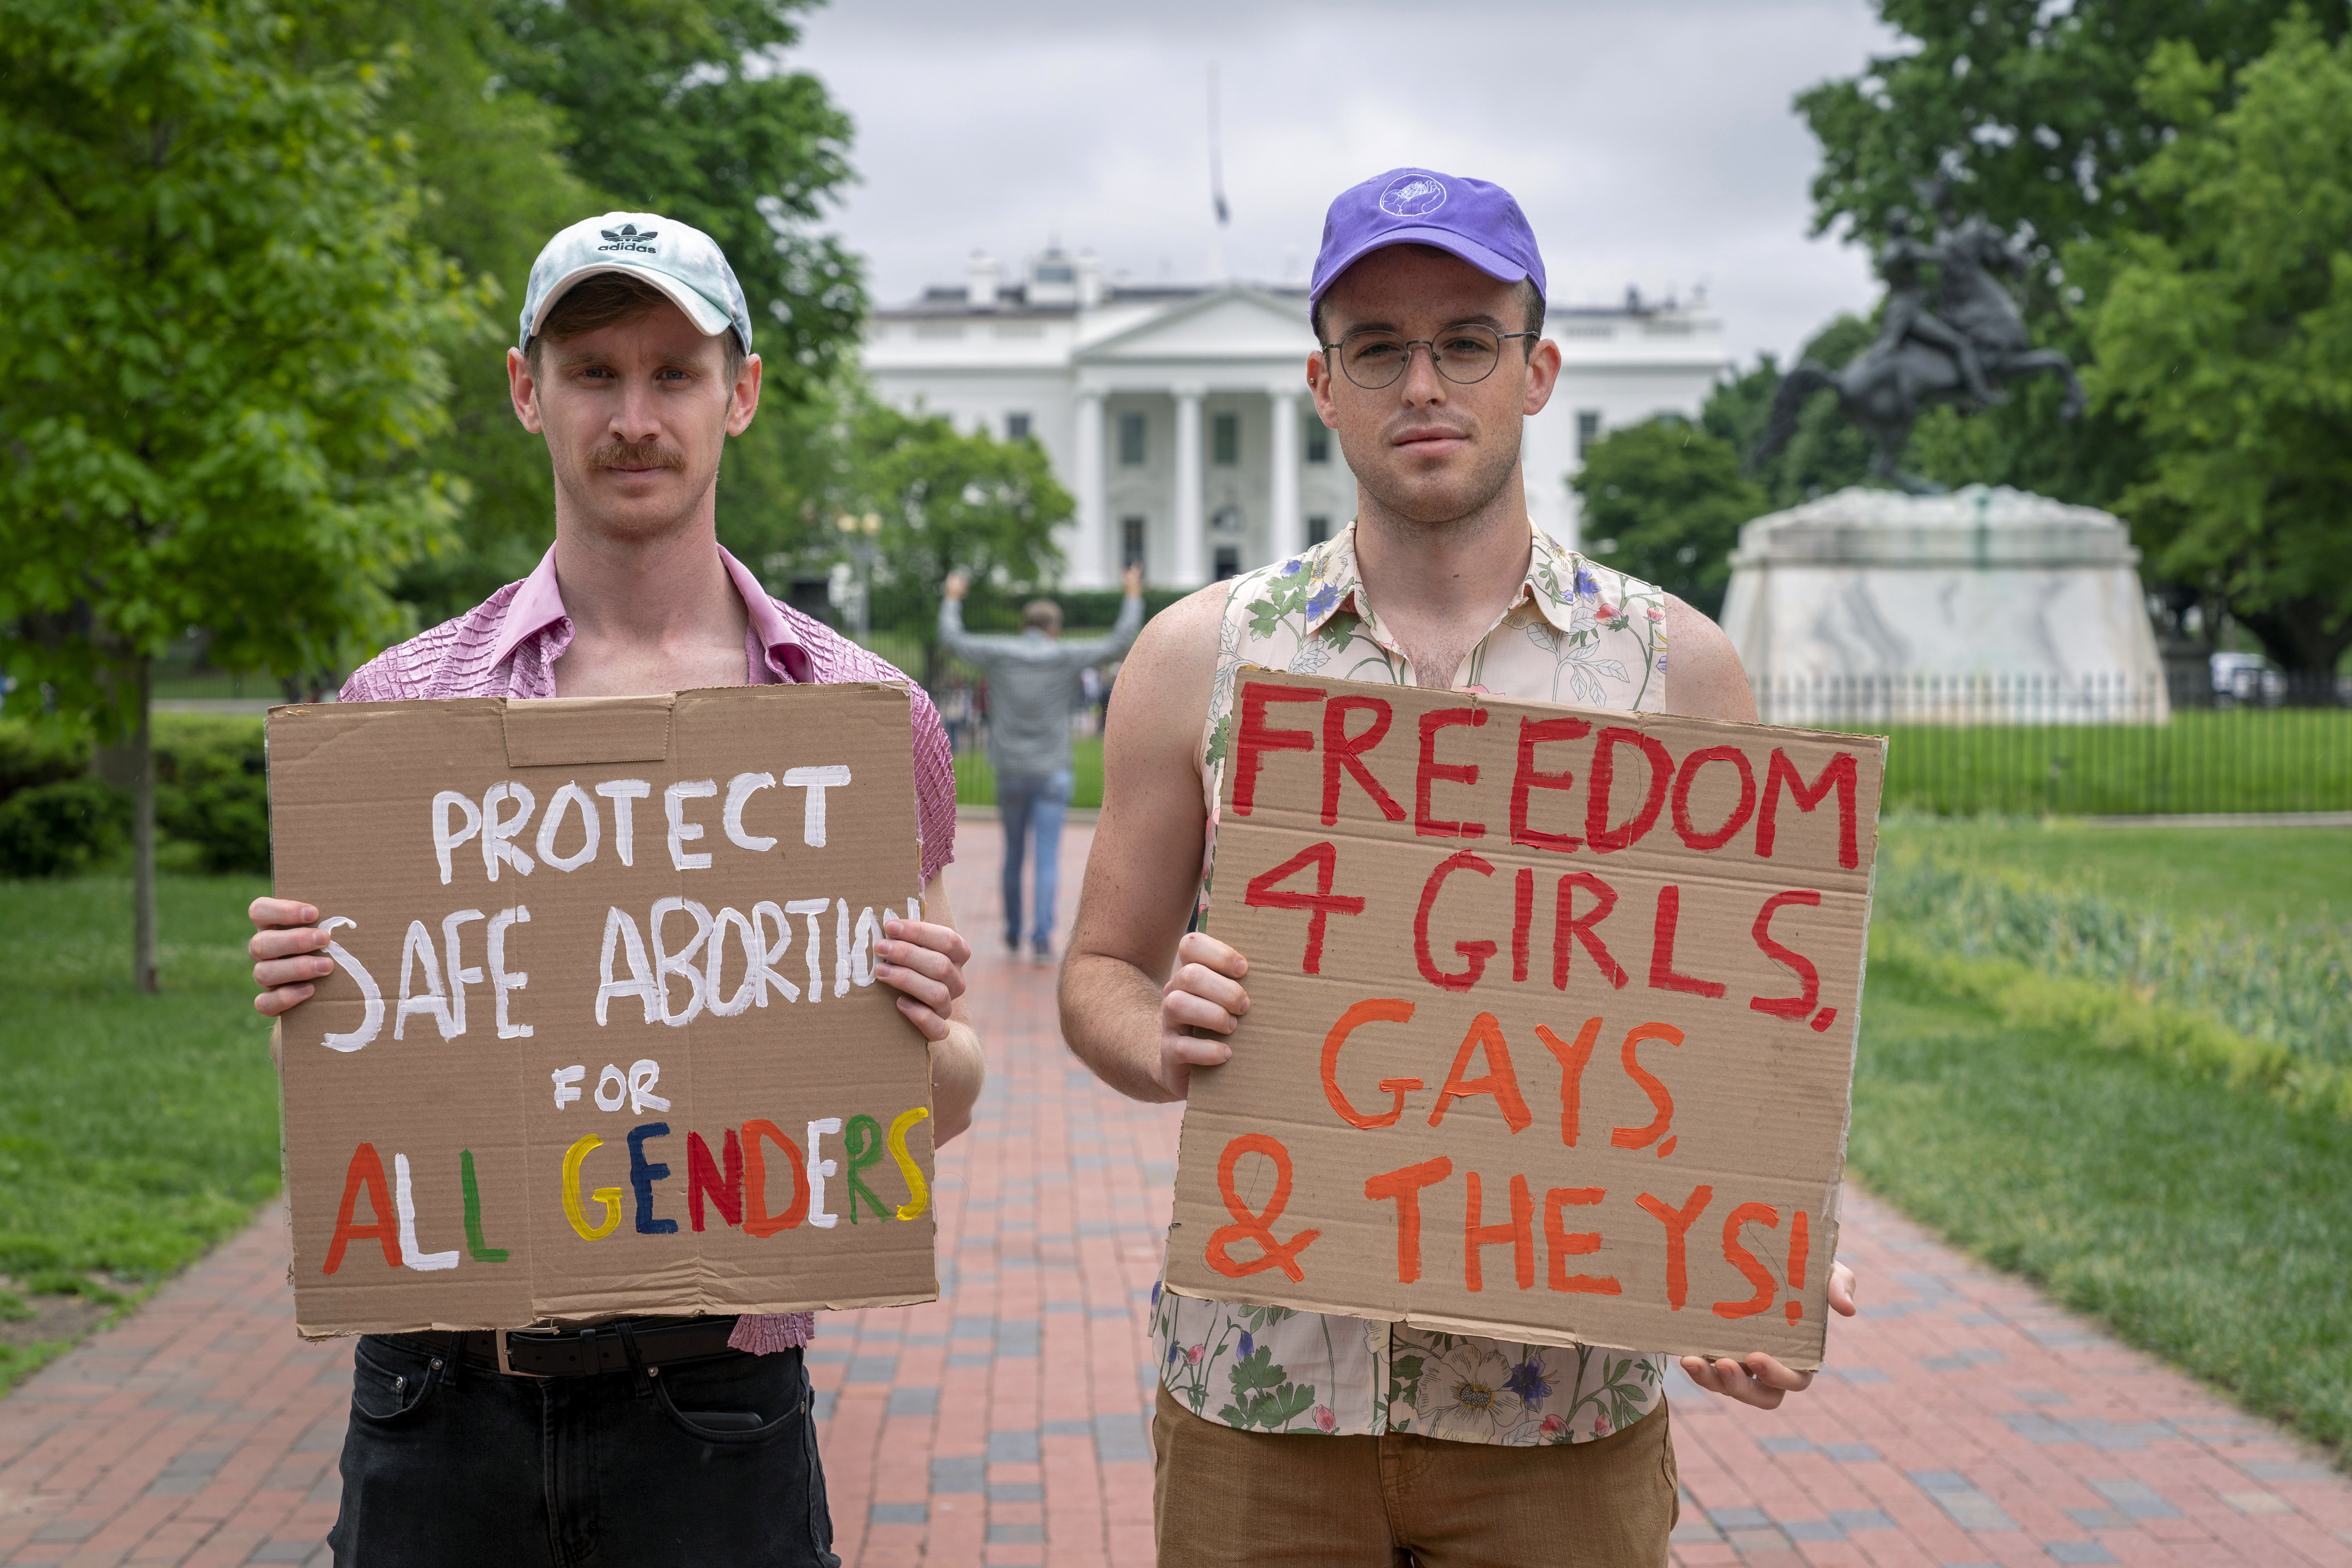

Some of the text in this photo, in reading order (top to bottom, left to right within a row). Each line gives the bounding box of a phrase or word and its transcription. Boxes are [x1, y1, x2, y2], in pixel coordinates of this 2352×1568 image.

[598, 243, 657, 254] adidas
[431, 765, 851, 884] PROTECT
[1231, 682, 1858, 870] FREEDOM
[319, 904, 534, 1053] SAFE
[1245, 841, 1837, 1033] 4 GIRLS,
[552, 1059, 671, 1115] FOR
[1320, 998, 1685, 1158] GAYS,
[323, 1107, 929, 1276] ALL GENDERS
[1204, 1133, 1810, 1326] & THEYS!
